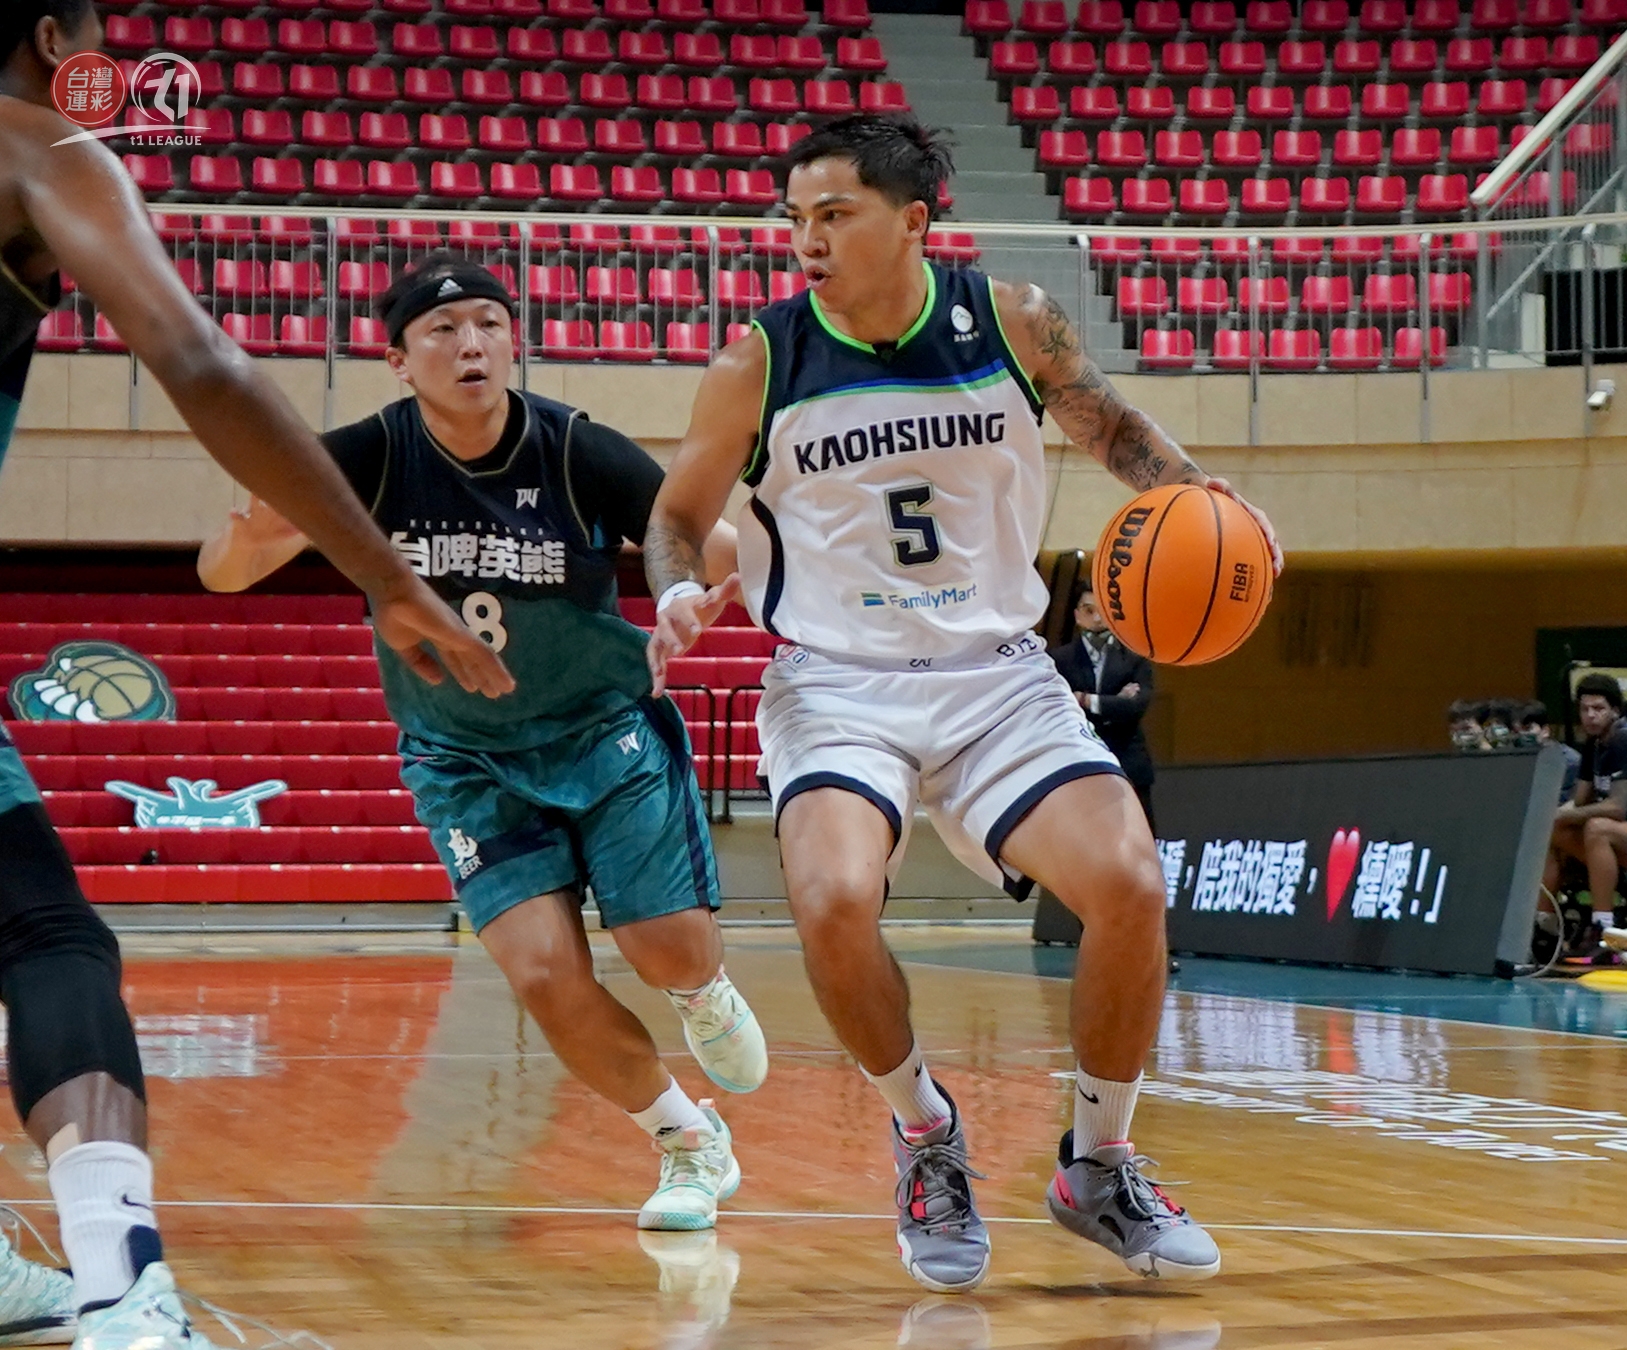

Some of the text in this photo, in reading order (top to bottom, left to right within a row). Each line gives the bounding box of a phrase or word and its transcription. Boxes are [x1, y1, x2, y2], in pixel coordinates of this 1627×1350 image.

[793, 411, 1007, 475] KAOHSIUNG
[884, 482, 945, 570] 5
[1107, 507, 1154, 620] Wilson
[1230, 563, 1249, 601] FIBA
[461, 591, 508, 654] 8
[888, 582, 978, 611] FamilyMart
[458, 855, 484, 880] BEER
